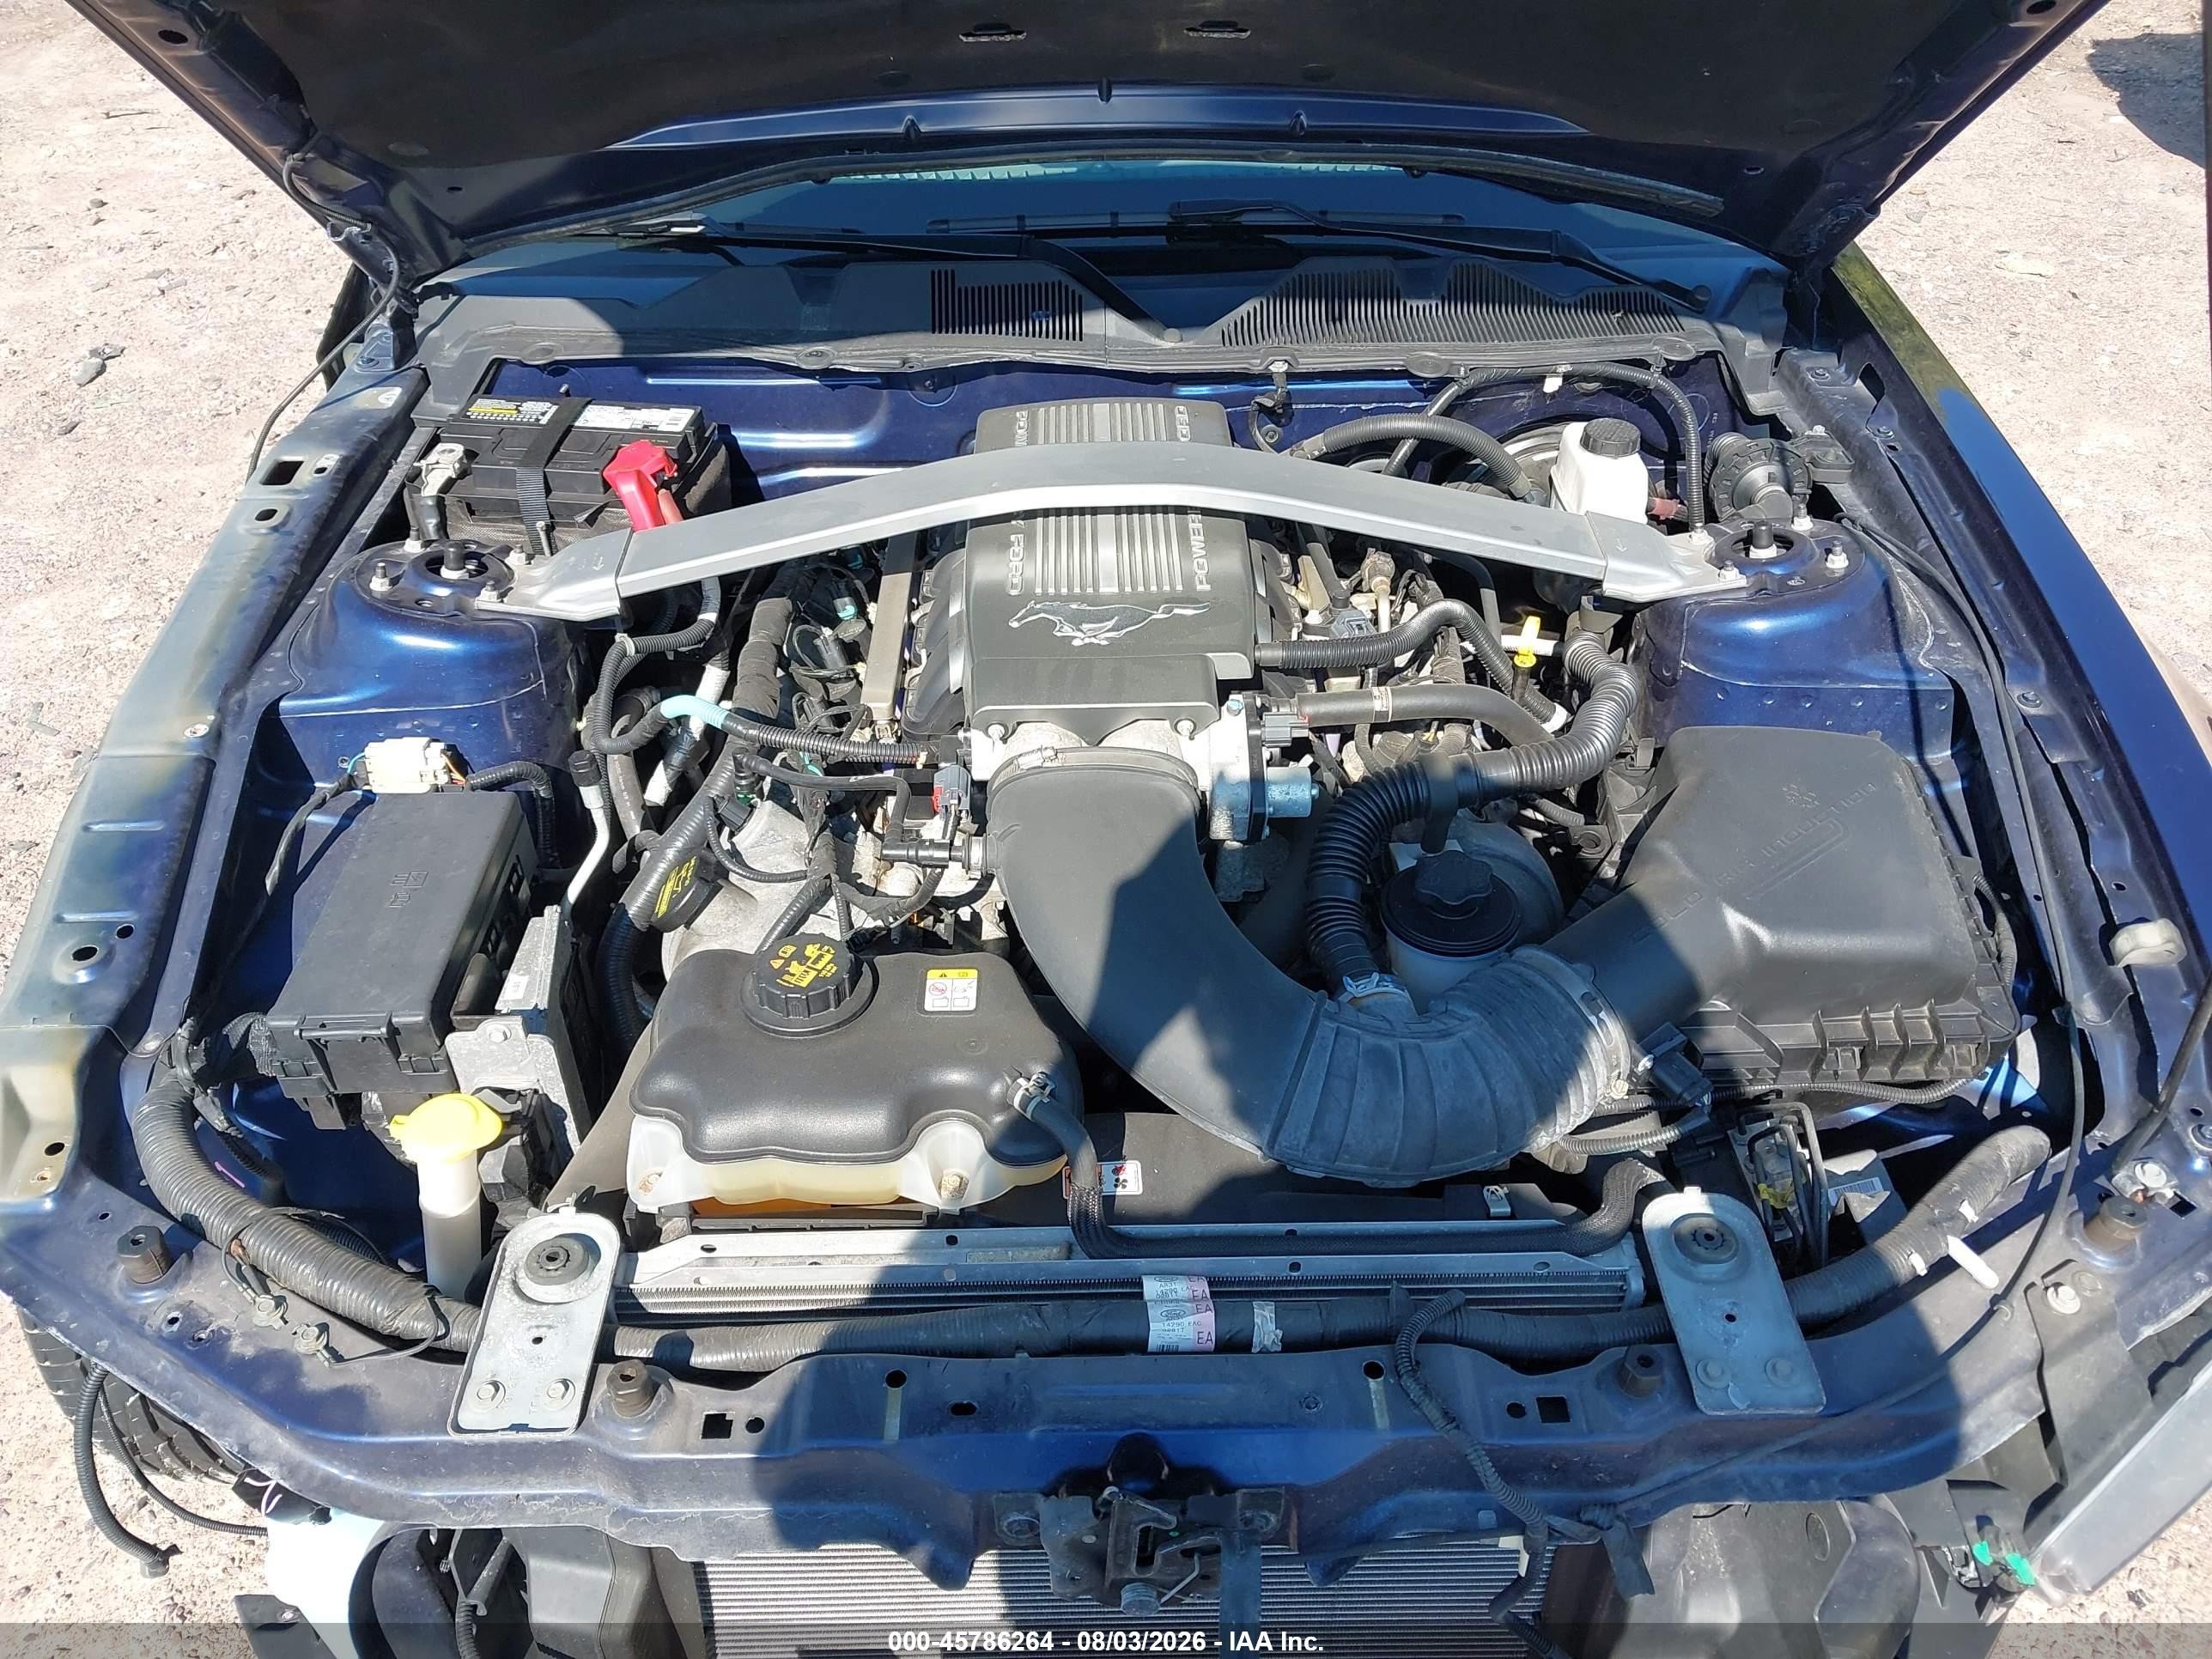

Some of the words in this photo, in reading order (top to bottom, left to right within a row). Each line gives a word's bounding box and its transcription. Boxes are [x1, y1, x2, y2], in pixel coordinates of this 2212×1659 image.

[1009, 533, 1024, 596] FORD
[1187, 510, 1212, 592] POWER
[1197, 1331, 1214, 1346] EA
